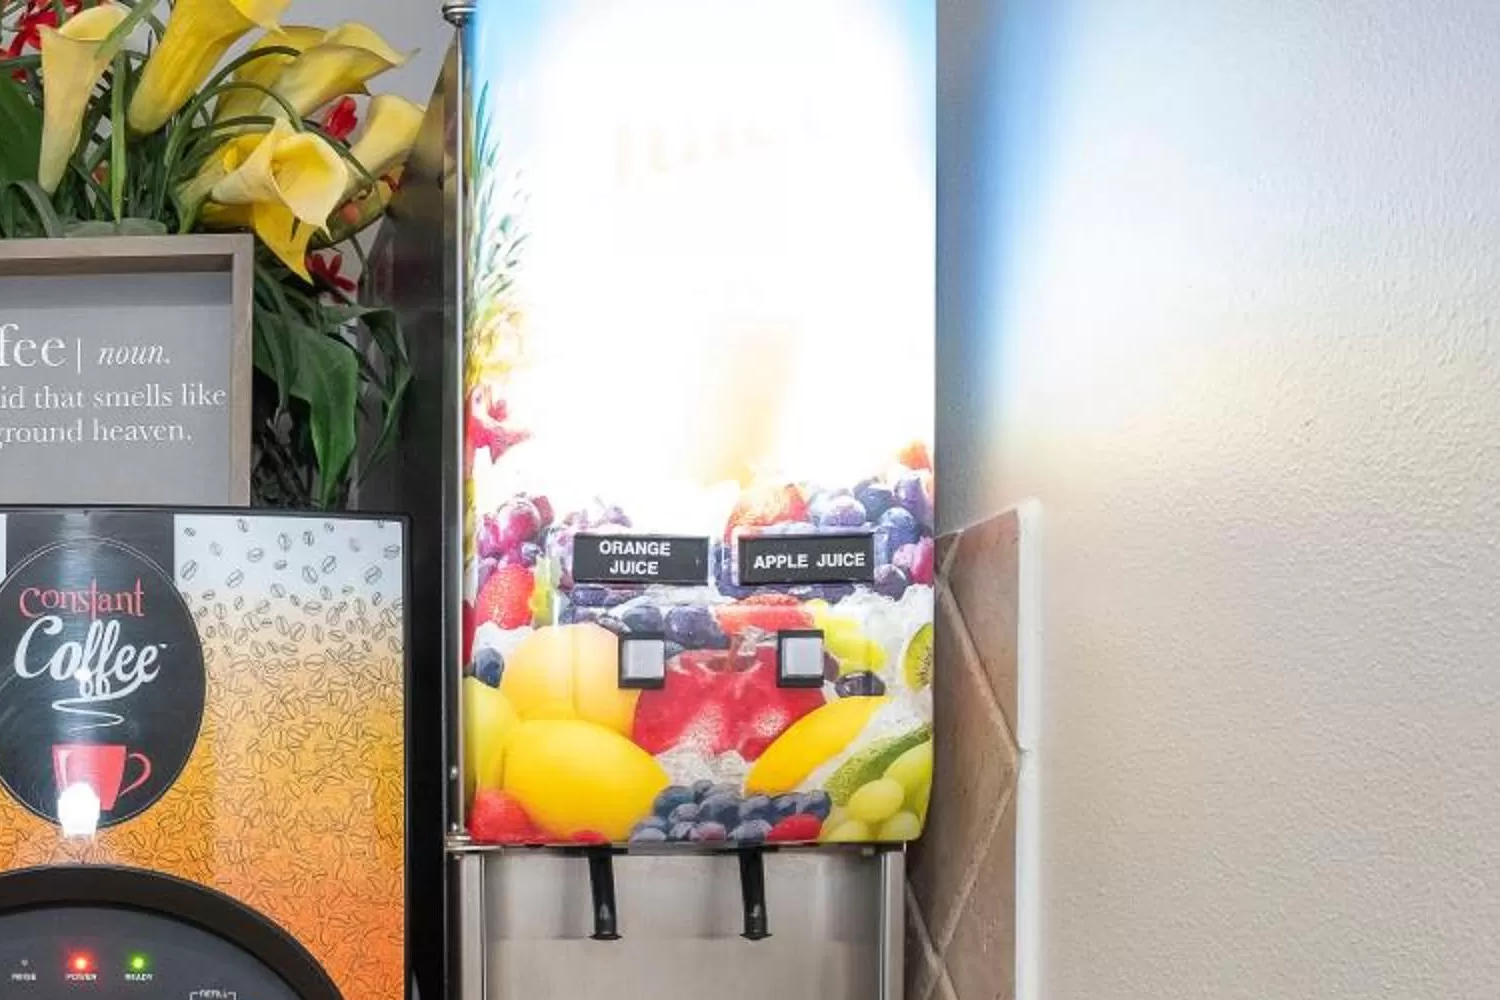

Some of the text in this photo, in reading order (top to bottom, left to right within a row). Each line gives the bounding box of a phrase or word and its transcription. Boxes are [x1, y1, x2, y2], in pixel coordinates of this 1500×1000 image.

[98, 343, 172, 366] noun.
[34, 386, 85, 410] that
[93, 383, 173, 408] smells
[181, 382, 227, 407] like
[92, 417, 193, 443] heaven.
[599, 539, 671, 557] ORANGE
[753, 551, 866, 569] APPLE JUICE
[609, 560, 659, 575] JUICE
[19, 576, 145, 622] constant
[13, 615, 162, 698] Coffee
